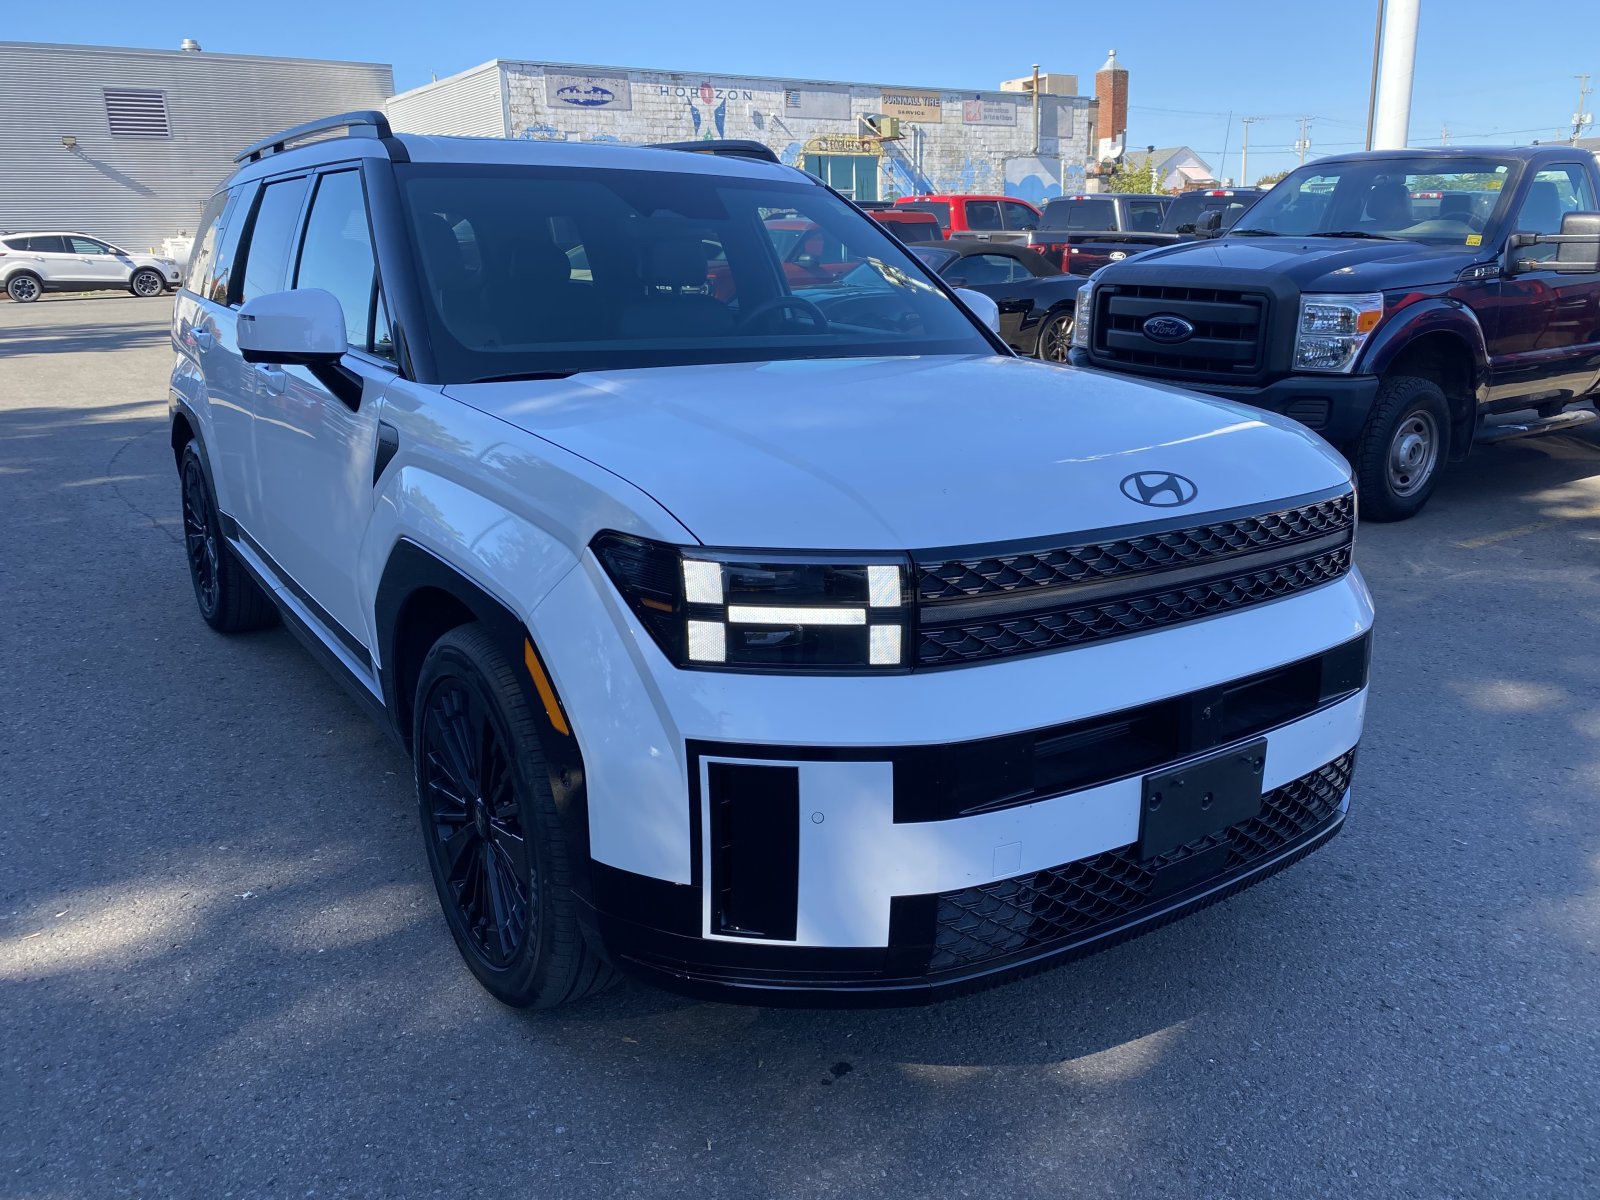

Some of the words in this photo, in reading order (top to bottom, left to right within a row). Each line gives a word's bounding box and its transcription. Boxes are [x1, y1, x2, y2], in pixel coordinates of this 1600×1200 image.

[660, 86, 752, 101] HORIZON
[923, 97, 941, 108] TIRE
[1152, 320, 1179, 336] Ford
[527, 868, 538, 962] NEXEN
